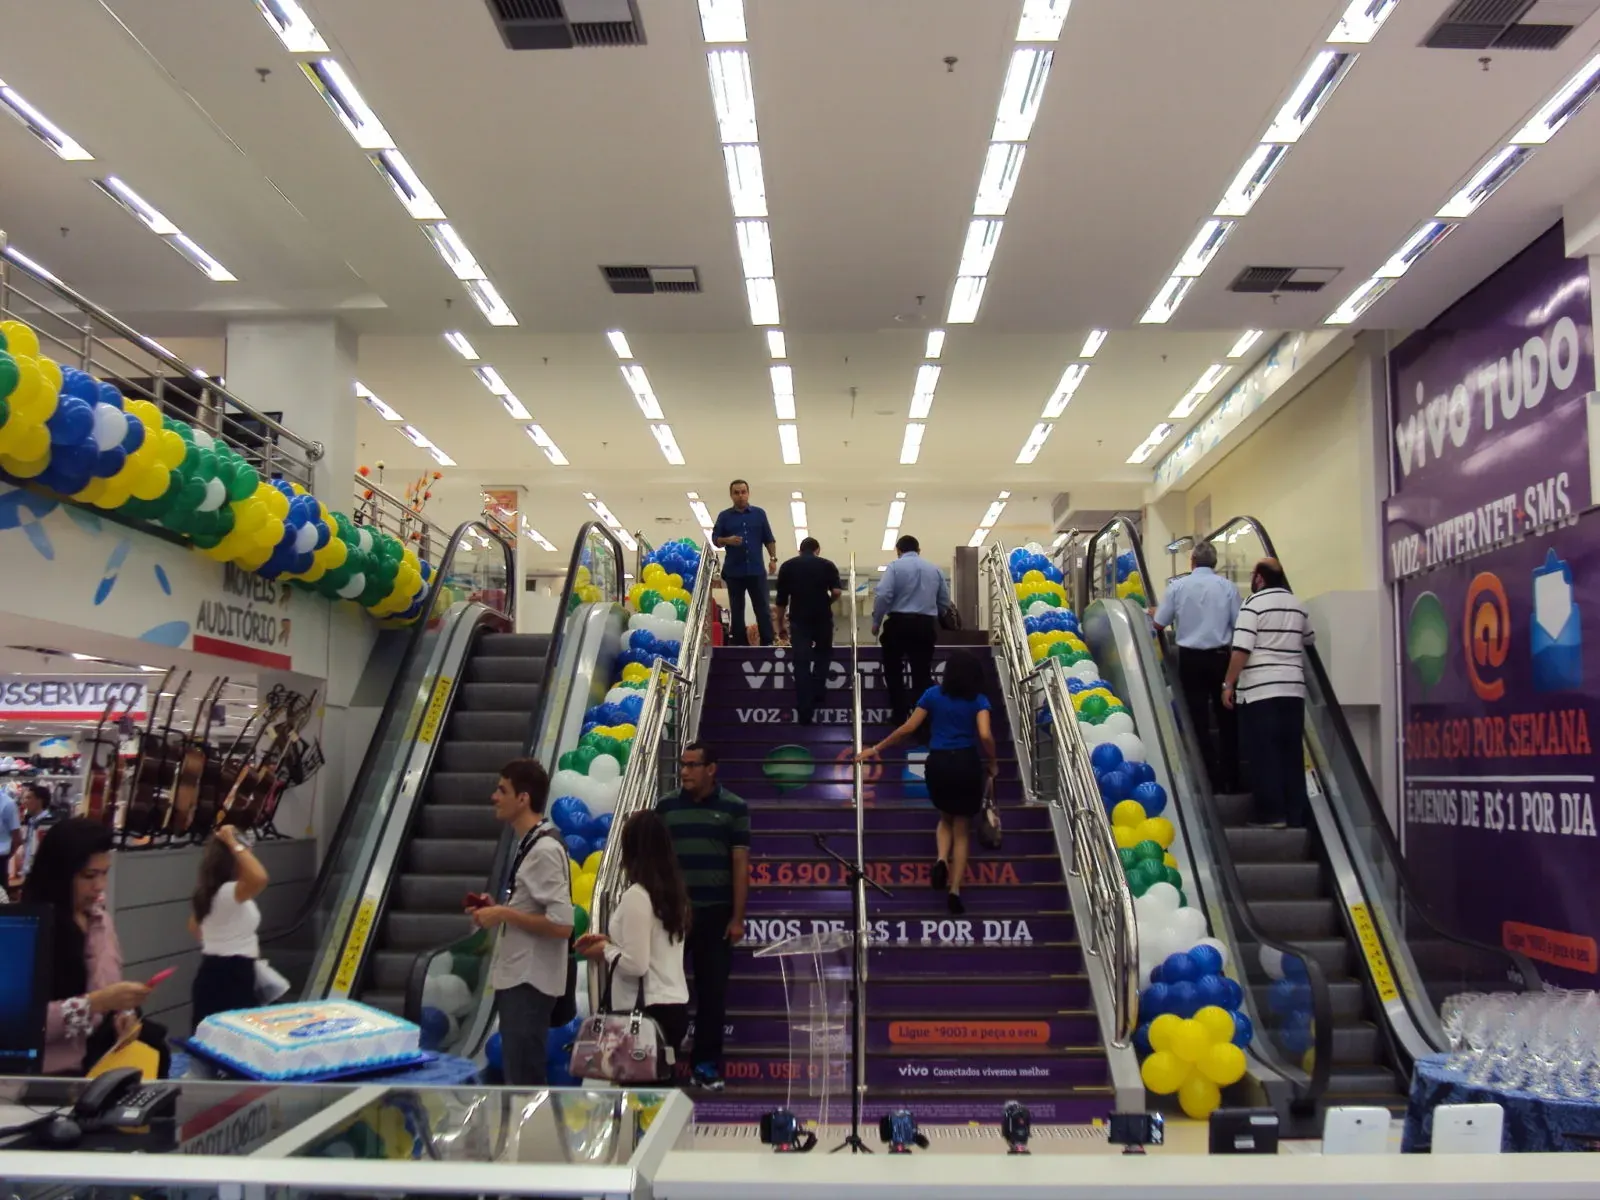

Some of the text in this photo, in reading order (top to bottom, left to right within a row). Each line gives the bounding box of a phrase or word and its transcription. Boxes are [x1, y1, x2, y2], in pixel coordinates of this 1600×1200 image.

[1477, 316, 1579, 430] TUDO
[1392, 534, 1420, 578] VOZ
[1425, 494, 1516, 567] INTERNET
[1525, 472, 1571, 530] SMS
[196, 600, 276, 646] AUDITÓRIO
[736, 708, 781, 723] VOZ
[1472, 715, 1508, 759] POR
[1509, 709, 1592, 758] SEMANA
[1461, 790, 1480, 828] DE
[1521, 791, 1557, 834] POR
[1560, 792, 1597, 836] DIA
[900, 862, 1020, 885] SEANA
[896, 920, 909, 941] 1
[921, 919, 975, 941] POR
[982, 919, 1034, 941] DIA
[898, 1026, 931, 1040] Ligue
[769, 1061, 801, 1079] USE
[898, 1064, 929, 1076] vivo
[933, 1066, 980, 1077] Conectados
[982, 1066, 1017, 1077] vivemos
